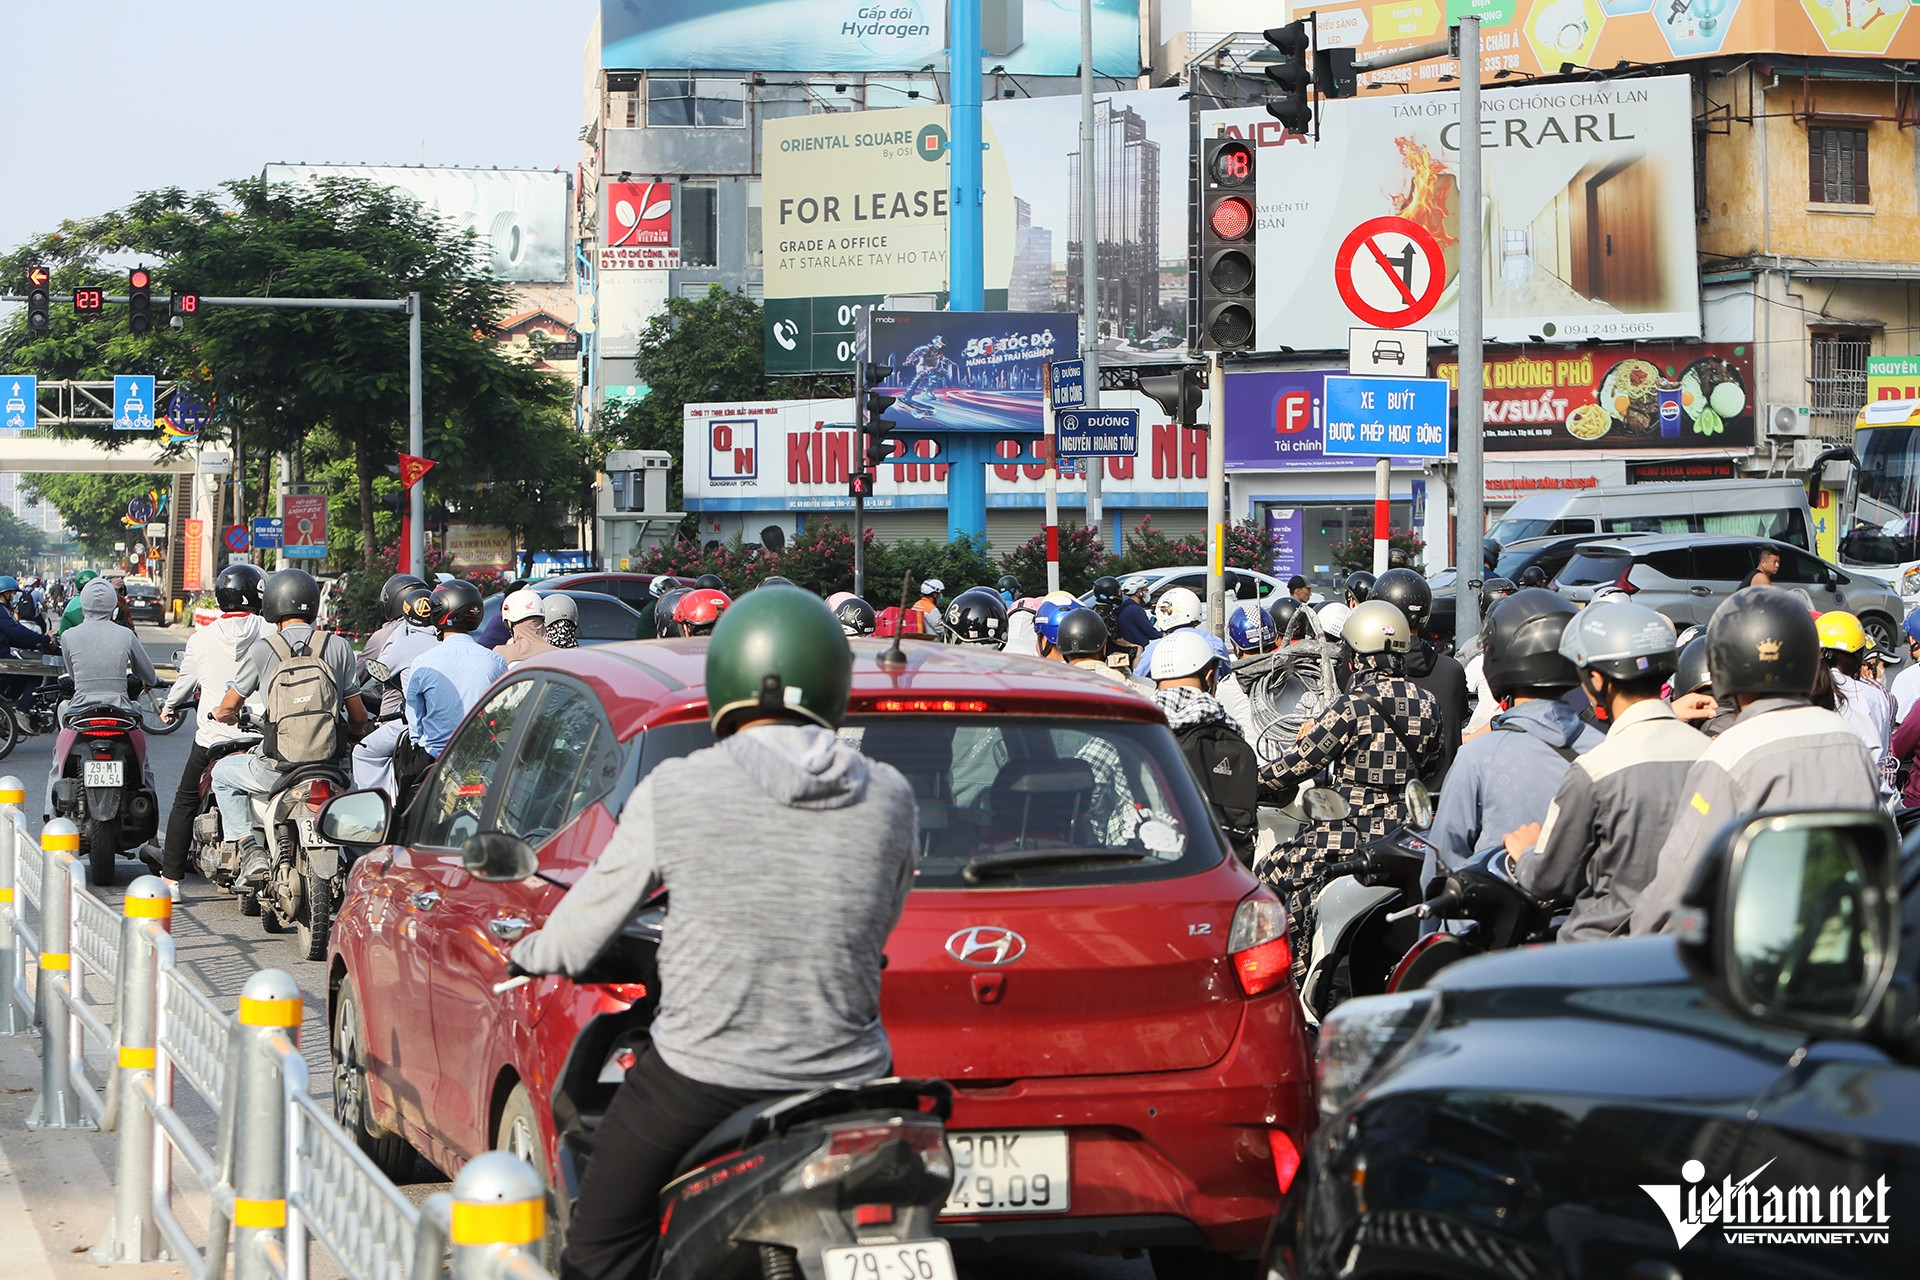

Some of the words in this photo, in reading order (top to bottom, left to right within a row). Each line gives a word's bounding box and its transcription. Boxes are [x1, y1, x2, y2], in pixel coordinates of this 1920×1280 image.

[858, 5, 886, 21] Gấp
[890, 8, 913, 19] đôi
[841, 22, 930, 38] Hydrogen
[1328, 35, 1341, 45] LED
[1486, 31, 1508, 53] CHÂU
[1484, 57, 1501, 72] 335
[1509, 93, 1566, 111] CHỐNG
[1569, 89, 1612, 108] CHÁY
[1616, 90, 1649, 103] LAN
[780, 135, 849, 152] ORIENTAL
[855, 130, 912, 147] SQUARE
[883, 150, 893, 159] By
[897, 148, 912, 156] OSI
[1227, 152, 1249, 178] 18
[780, 196, 840, 225] FOR
[855, 189, 947, 221] LEASE
[1257, 216, 1285, 230] BẢN
[780, 239, 823, 252] GRADE
[827, 239, 837, 250] A
[841, 236, 887, 249] OFFICE
[780, 258, 795, 269] AT
[800, 255, 863, 268] STARLAKE
[868, 253, 892, 265] TAY
[897, 252, 917, 264] HO
[922, 251, 947, 263] TAY
[76, 291, 99, 308] 123
[181, 295, 197, 312] 18
[875, 316, 911, 324] mobifone
[1564, 324, 1589, 335] 094
[1592, 323, 1617, 334] 249
[1621, 322, 1654, 333] 5665
[966, 337, 994, 358] 5G
[997, 332, 1029, 351] TỐC
[1031, 329, 1054, 348] ĐỘ
[1061, 366, 1081, 378] ĐƯỜNG
[1493, 355, 1554, 388] ĐƯỜNG
[1556, 351, 1593, 387] PHỐ
[1361, 391, 1374, 409] XE
[1388, 388, 1415, 410] BUÝT
[1087, 415, 1130, 427] ĐƯỜNG
[1329, 422, 1356, 442] ĐƯỢC
[1360, 420, 1385, 442] PHÉP
[1388, 424, 1412, 444] HOẠT
[1416, 422, 1442, 445] ĐỘNG
[1093, 433, 1119, 451] HOÀNG
[1119, 433, 1135, 451] TÔN
[1274, 440, 1290, 451] Tài
[1292, 440, 1322, 451] chính
[1660, 466, 1685, 475] STEAK
[293, 694, 314, 704] acer
[90, 762, 117, 773] 29-M1
[87, 774, 121, 785] 784.54
[1188, 923, 1212, 936] 1.2
[844, 1248, 934, 1280] 29-S6
